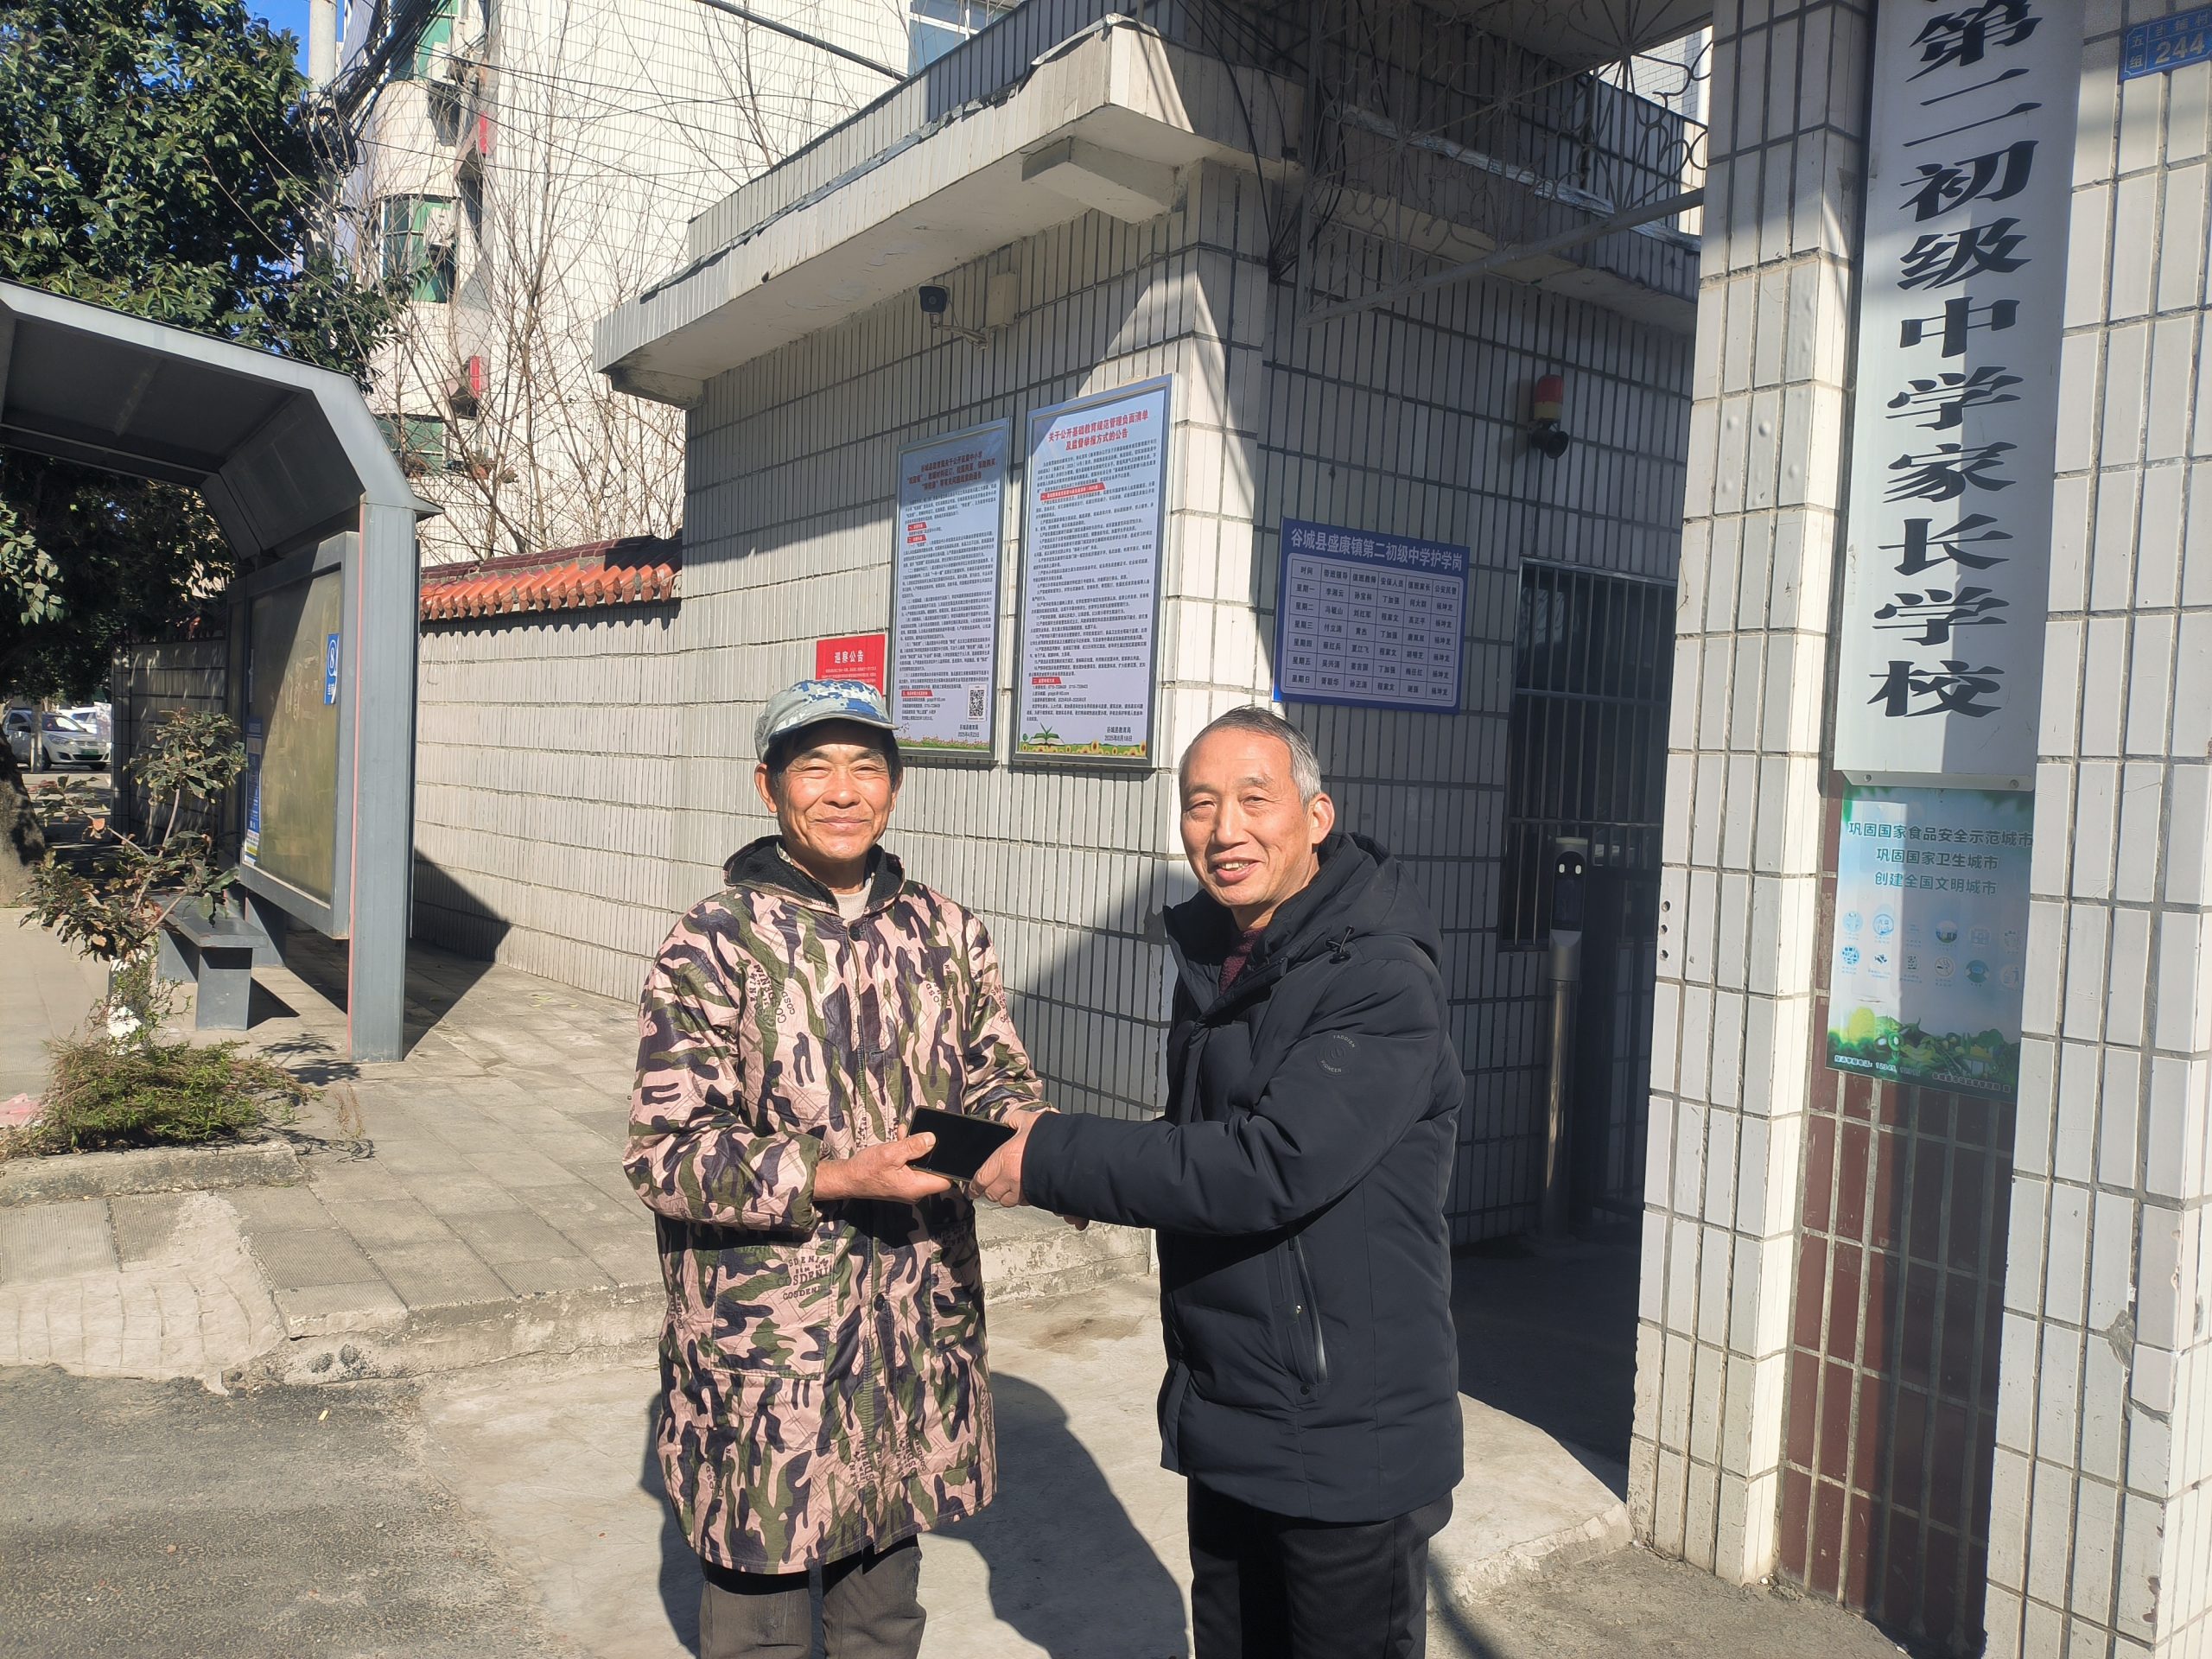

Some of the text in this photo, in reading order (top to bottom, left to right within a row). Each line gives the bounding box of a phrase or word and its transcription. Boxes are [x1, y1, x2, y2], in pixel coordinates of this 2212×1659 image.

[2155, 32, 2205, 65] 244
[1291, 528, 1462, 572] 谷城县盛康镇第二初级中学护学岗
[1848, 822, 2034, 849] 巩固国家食品安全示范城市
[1876, 849, 1999, 871] 巩固国家卫生城市
[1874, 871, 1998, 896] 创建全国文明城市
